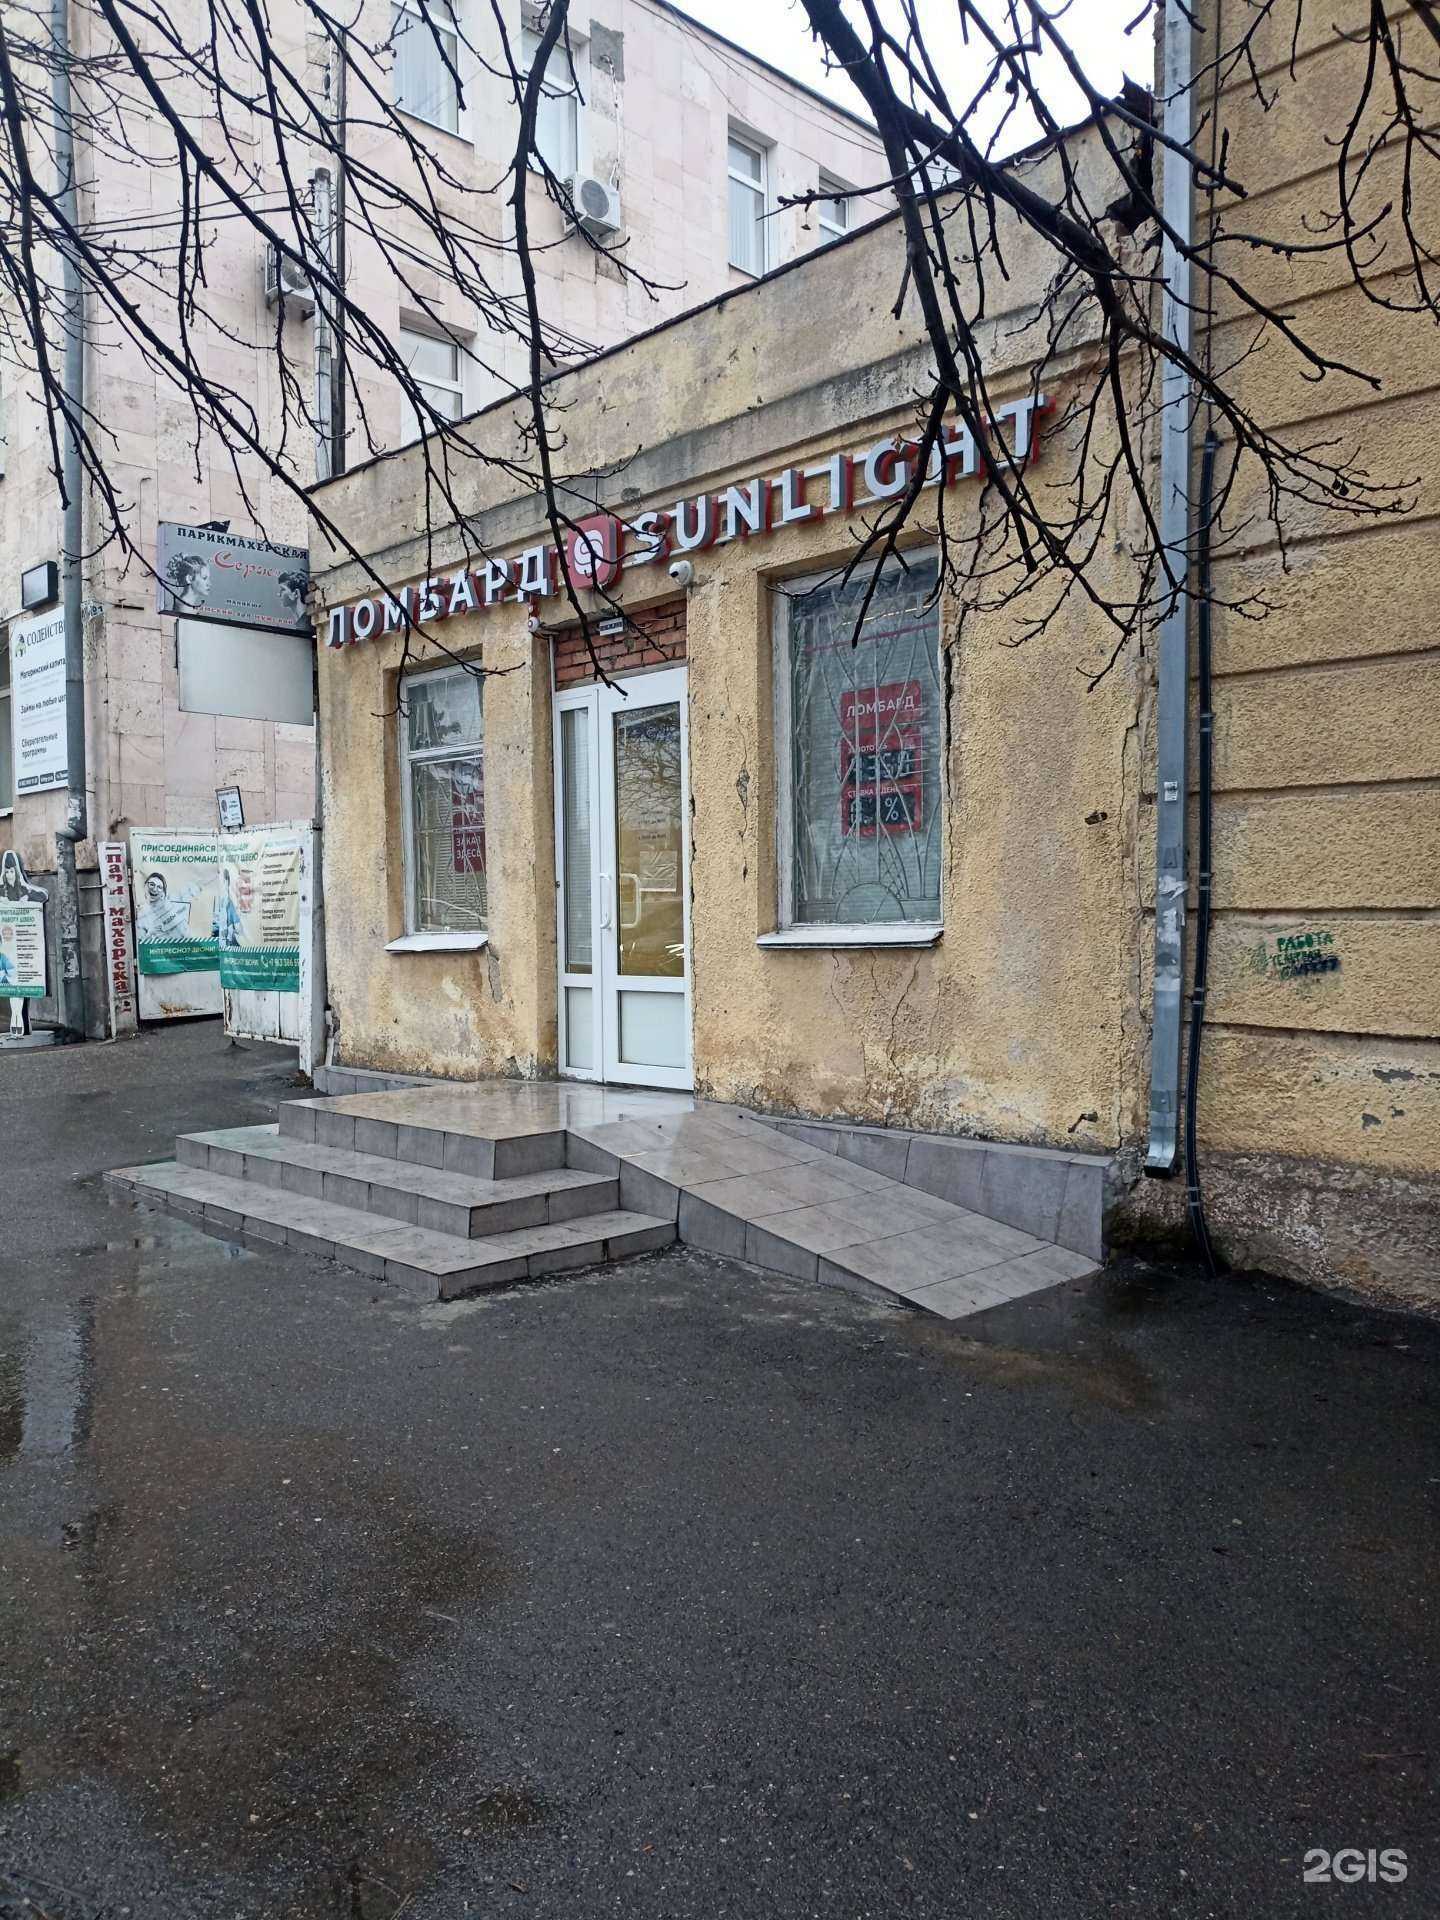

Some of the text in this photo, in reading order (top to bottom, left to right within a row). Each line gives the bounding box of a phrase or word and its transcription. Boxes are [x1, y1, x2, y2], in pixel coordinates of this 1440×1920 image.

[632, 394, 1046, 562] SUNLIGHT
[177, 527, 308, 560] ПАРИКМАХЕРСКАЯ
[327, 544, 556, 648] ЛОМБАРД
[26, 619, 65, 646] СОДЕЙСТВ
[846, 695, 915, 718] ЛОМБАРД
[847, 787, 875, 799] СТВКА
[141, 843, 216, 853] ПРИСОЕДИНЯЙСЯ
[150, 854, 180, 863] НАШЕЙ
[182, 854, 219, 864] КОМАНД
